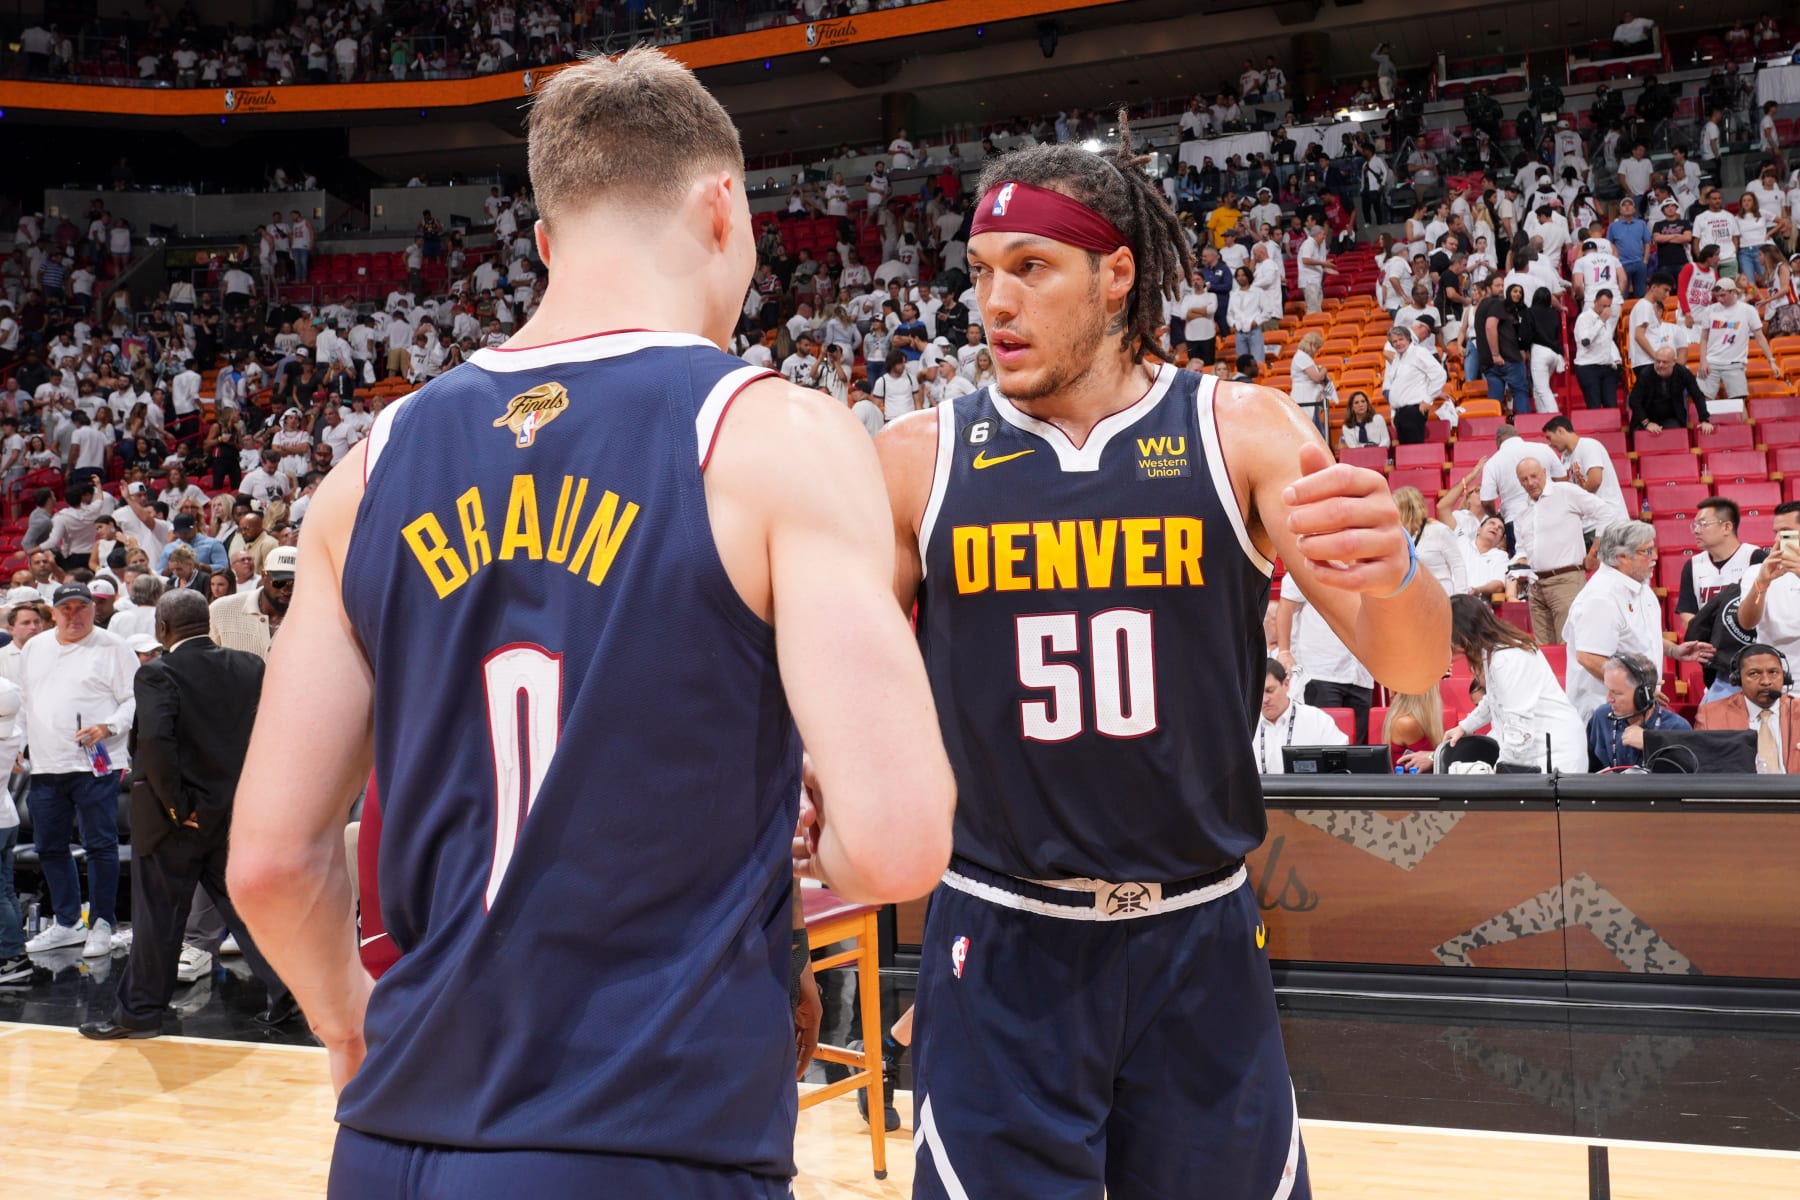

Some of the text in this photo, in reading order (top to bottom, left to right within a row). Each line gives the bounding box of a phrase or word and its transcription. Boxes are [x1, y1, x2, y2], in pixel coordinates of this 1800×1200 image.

[814, 20, 858, 47] Finals
[233, 89, 277, 111] Finals
[1594, 265, 1612, 283] 14
[1722, 333, 1737, 345] 14
[497, 391, 565, 423] Finals
[969, 421, 990, 443] 6
[1136, 436, 1186, 457] WU
[1138, 458, 1187, 469] Western
[1147, 466, 1181, 478] Union
[401, 474, 640, 599] BRAUN
[952, 516, 1205, 594] DENVER
[1013, 606, 1159, 744] 50
